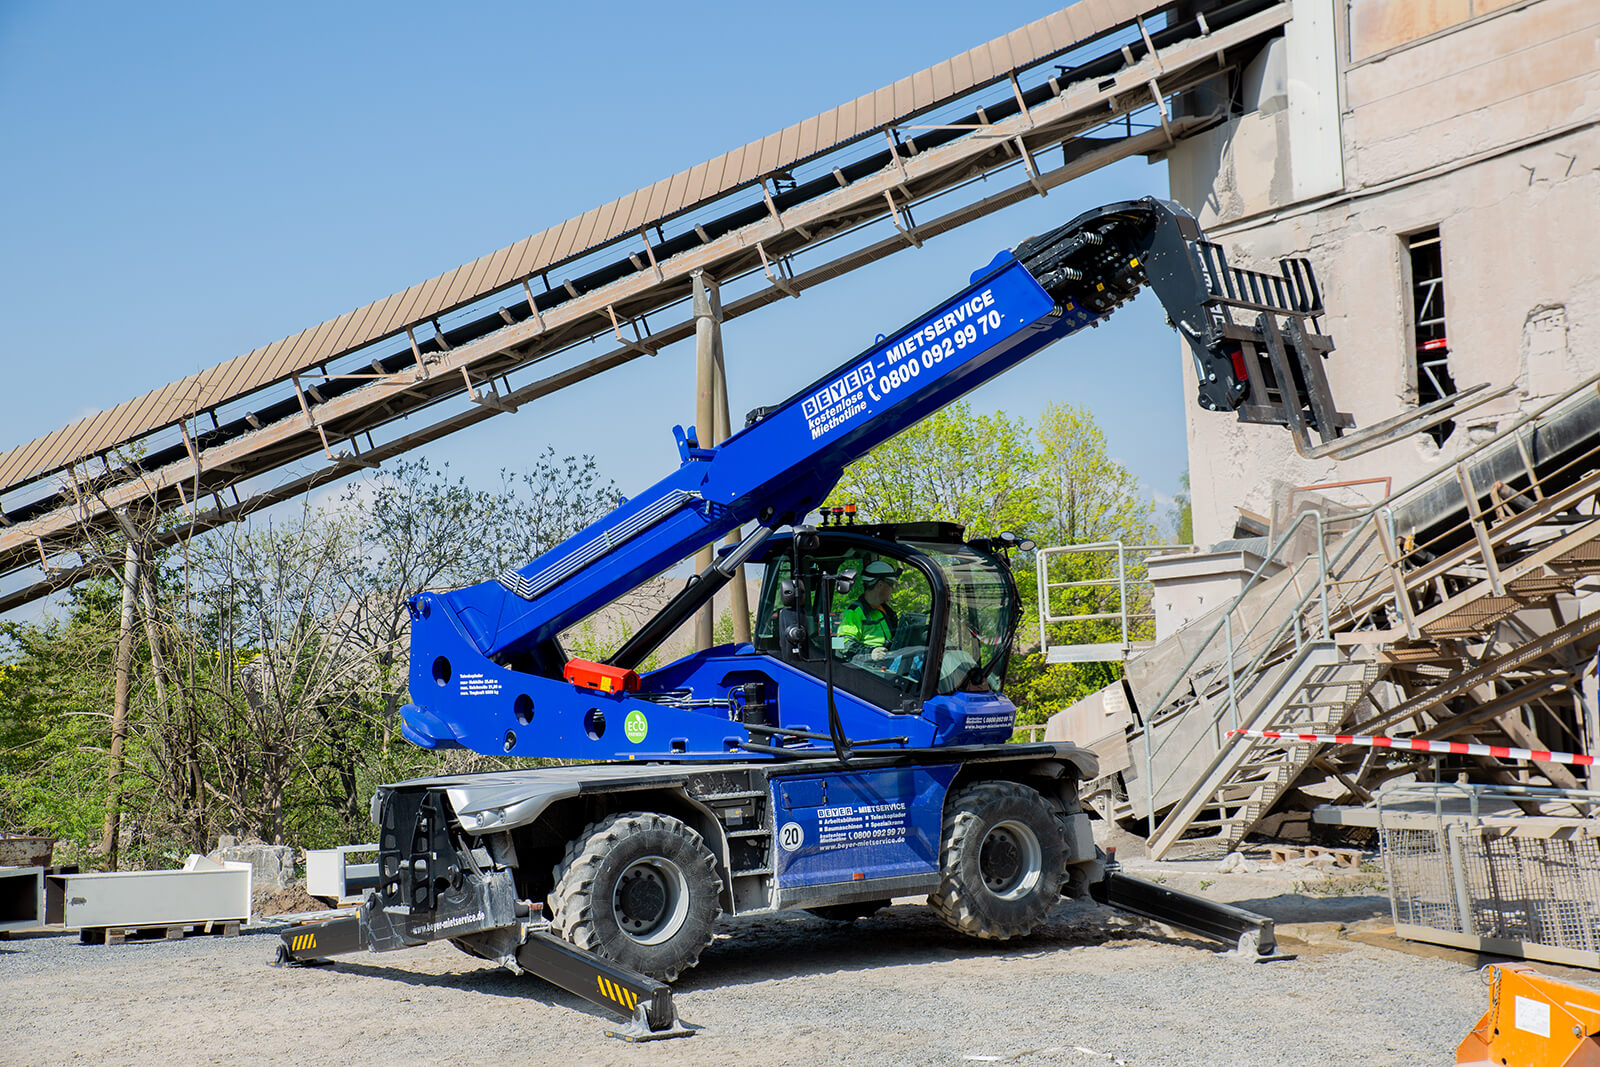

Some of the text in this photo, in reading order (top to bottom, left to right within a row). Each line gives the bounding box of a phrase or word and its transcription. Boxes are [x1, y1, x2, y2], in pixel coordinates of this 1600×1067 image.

[801, 361, 876, 420] BEYER
[886, 289, 995, 365] MIETSERVICE
[880, 309, 1001, 394] 0800 092 99 70
[808, 390, 864, 431] kostenlose
[811, 400, 867, 440] Miethotline
[627, 721, 645, 732] ECO
[817, 806, 853, 818] BEYER
[858, 803, 906, 813] MIETSERVICE
[824, 812, 906, 825] Arbeitsbühnen Teleskoplader
[824, 820, 904, 832] Baumaschinen Spezialkrane
[784, 827, 798, 845] 20
[853, 827, 906, 840] 0800 092 99 70
[819, 836, 906, 851] www.beyer-mietservice.de
